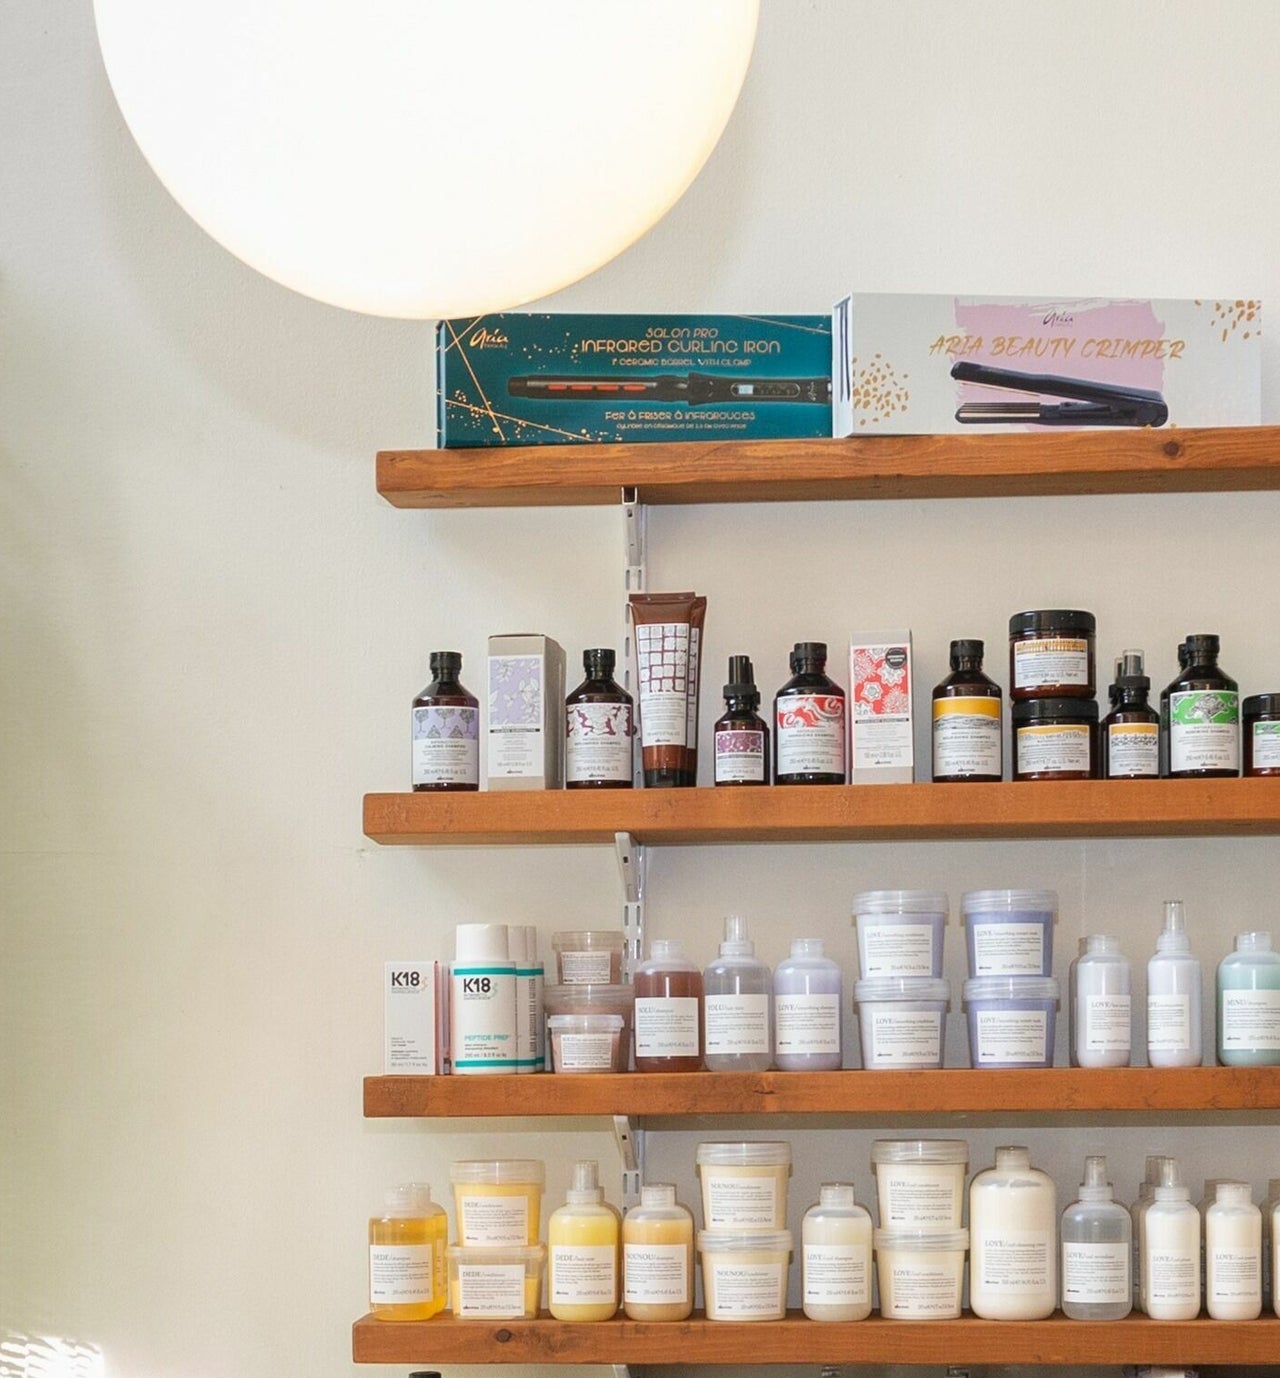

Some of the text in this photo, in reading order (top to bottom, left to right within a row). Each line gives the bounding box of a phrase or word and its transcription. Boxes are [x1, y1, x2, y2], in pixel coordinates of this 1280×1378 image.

[645, 328, 718, 339] SALON PRO
[581, 340, 781, 353] INFRARED CURLING IRON
[929, 335, 1185, 360] ARIA BEAUTY CRIMPER
[391, 971, 420, 986] K18
[463, 977, 491, 993] K18
